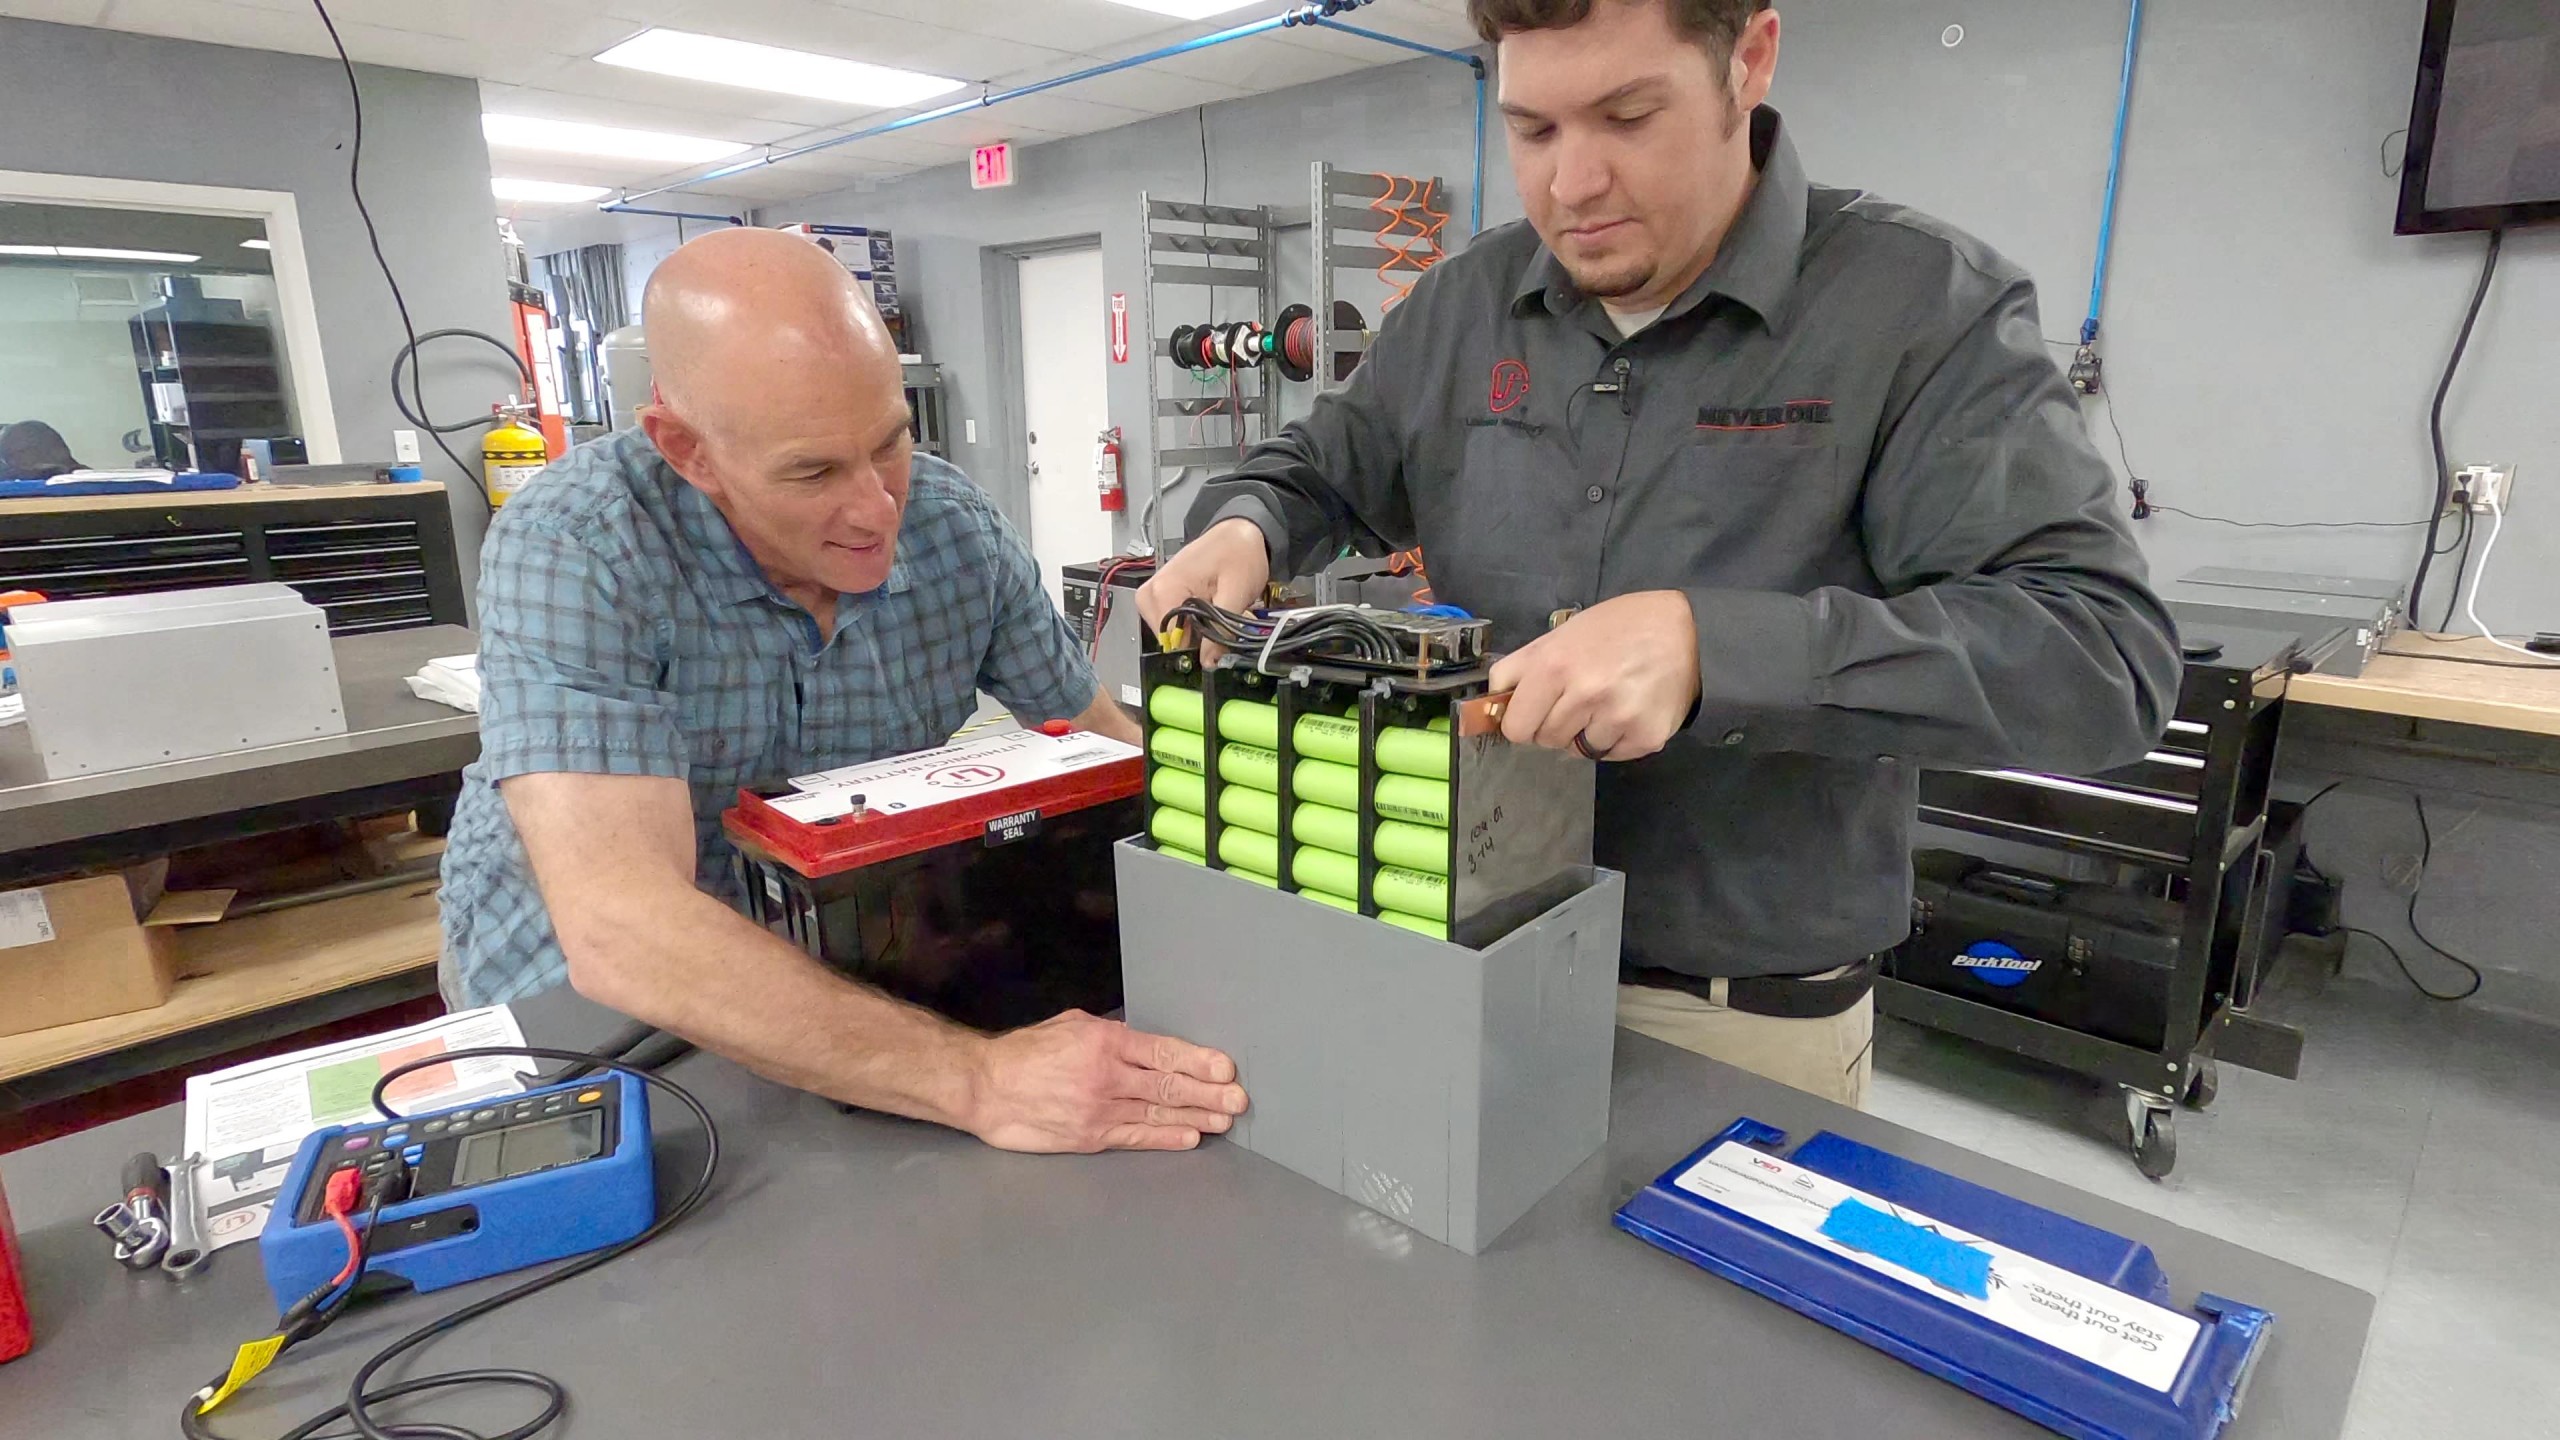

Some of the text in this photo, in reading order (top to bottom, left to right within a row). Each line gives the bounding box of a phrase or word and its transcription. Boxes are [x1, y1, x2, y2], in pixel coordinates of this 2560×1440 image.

[924, 743, 1027, 767] LITHIONICS
[988, 810, 1037, 832] WARRANTY
[1003, 825, 1025, 841] SEAL
[1951, 955, 2043, 971] ParkTool
[2083, 1315, 2118, 1335] out
[2086, 1306, 2120, 1324] out
[2121, 1331, 2158, 1352] Get
[2123, 1321, 2165, 1342] stay
